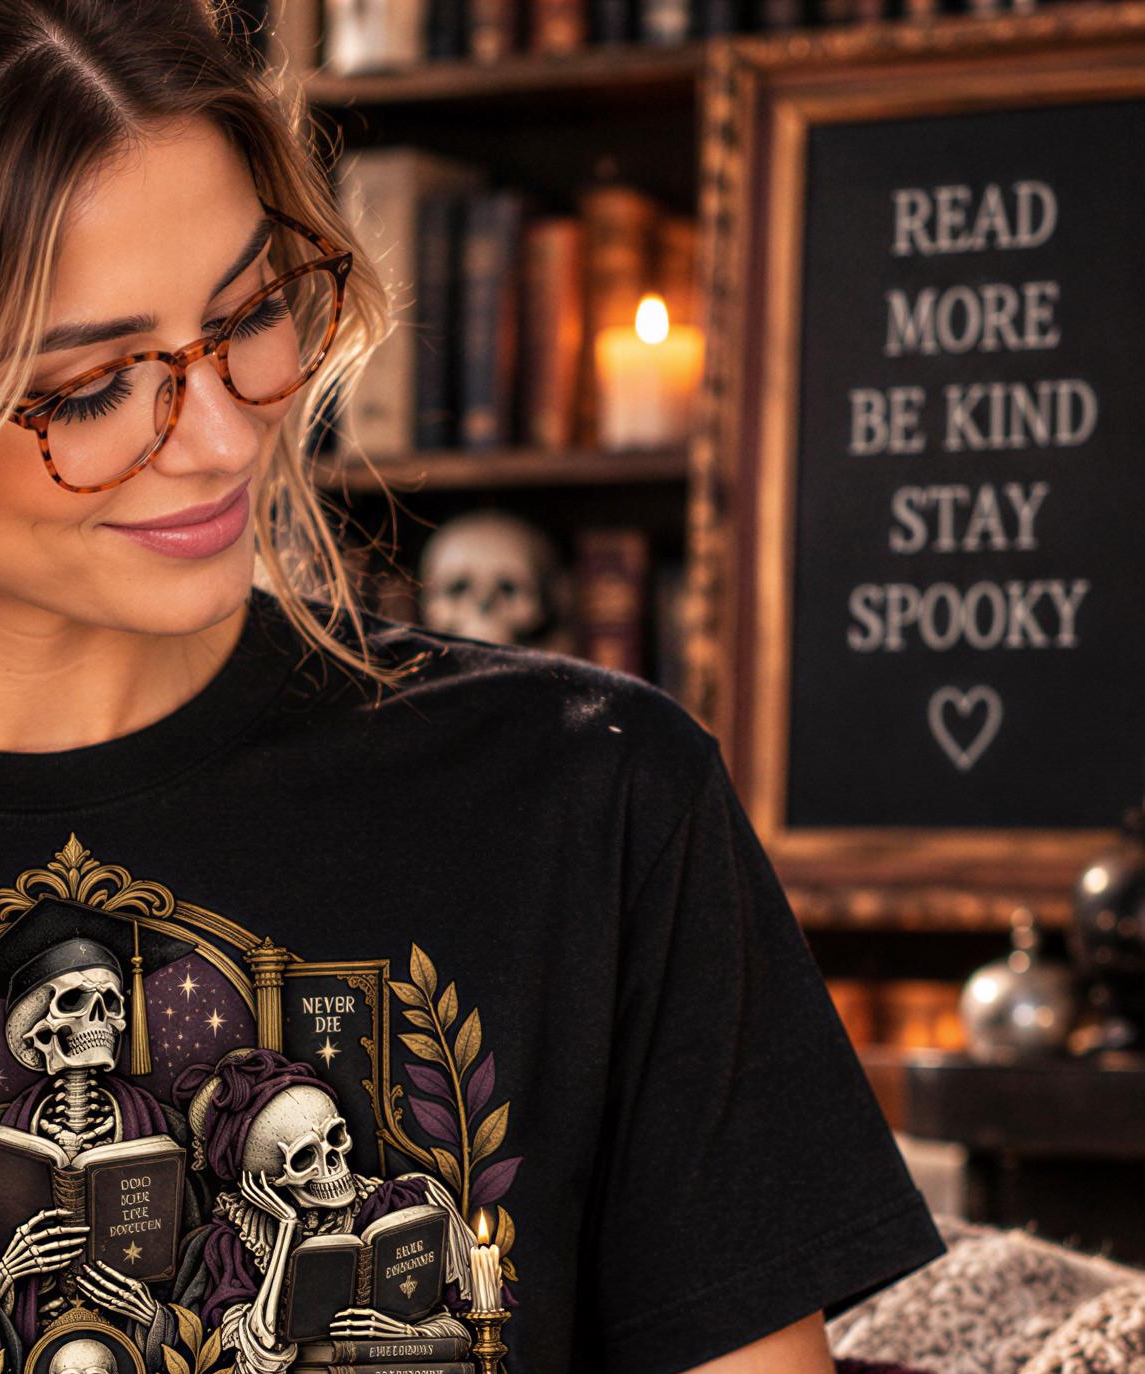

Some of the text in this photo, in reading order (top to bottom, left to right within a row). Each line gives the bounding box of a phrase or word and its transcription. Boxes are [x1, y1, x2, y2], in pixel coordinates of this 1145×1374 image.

[892, 180, 1058, 257] READ
[885, 280, 1060, 357] MORE
[849, 379, 1098, 456] BE KIND
[888, 481, 1048, 554] STAY
[846, 579, 1089, 652] SPOOKY
